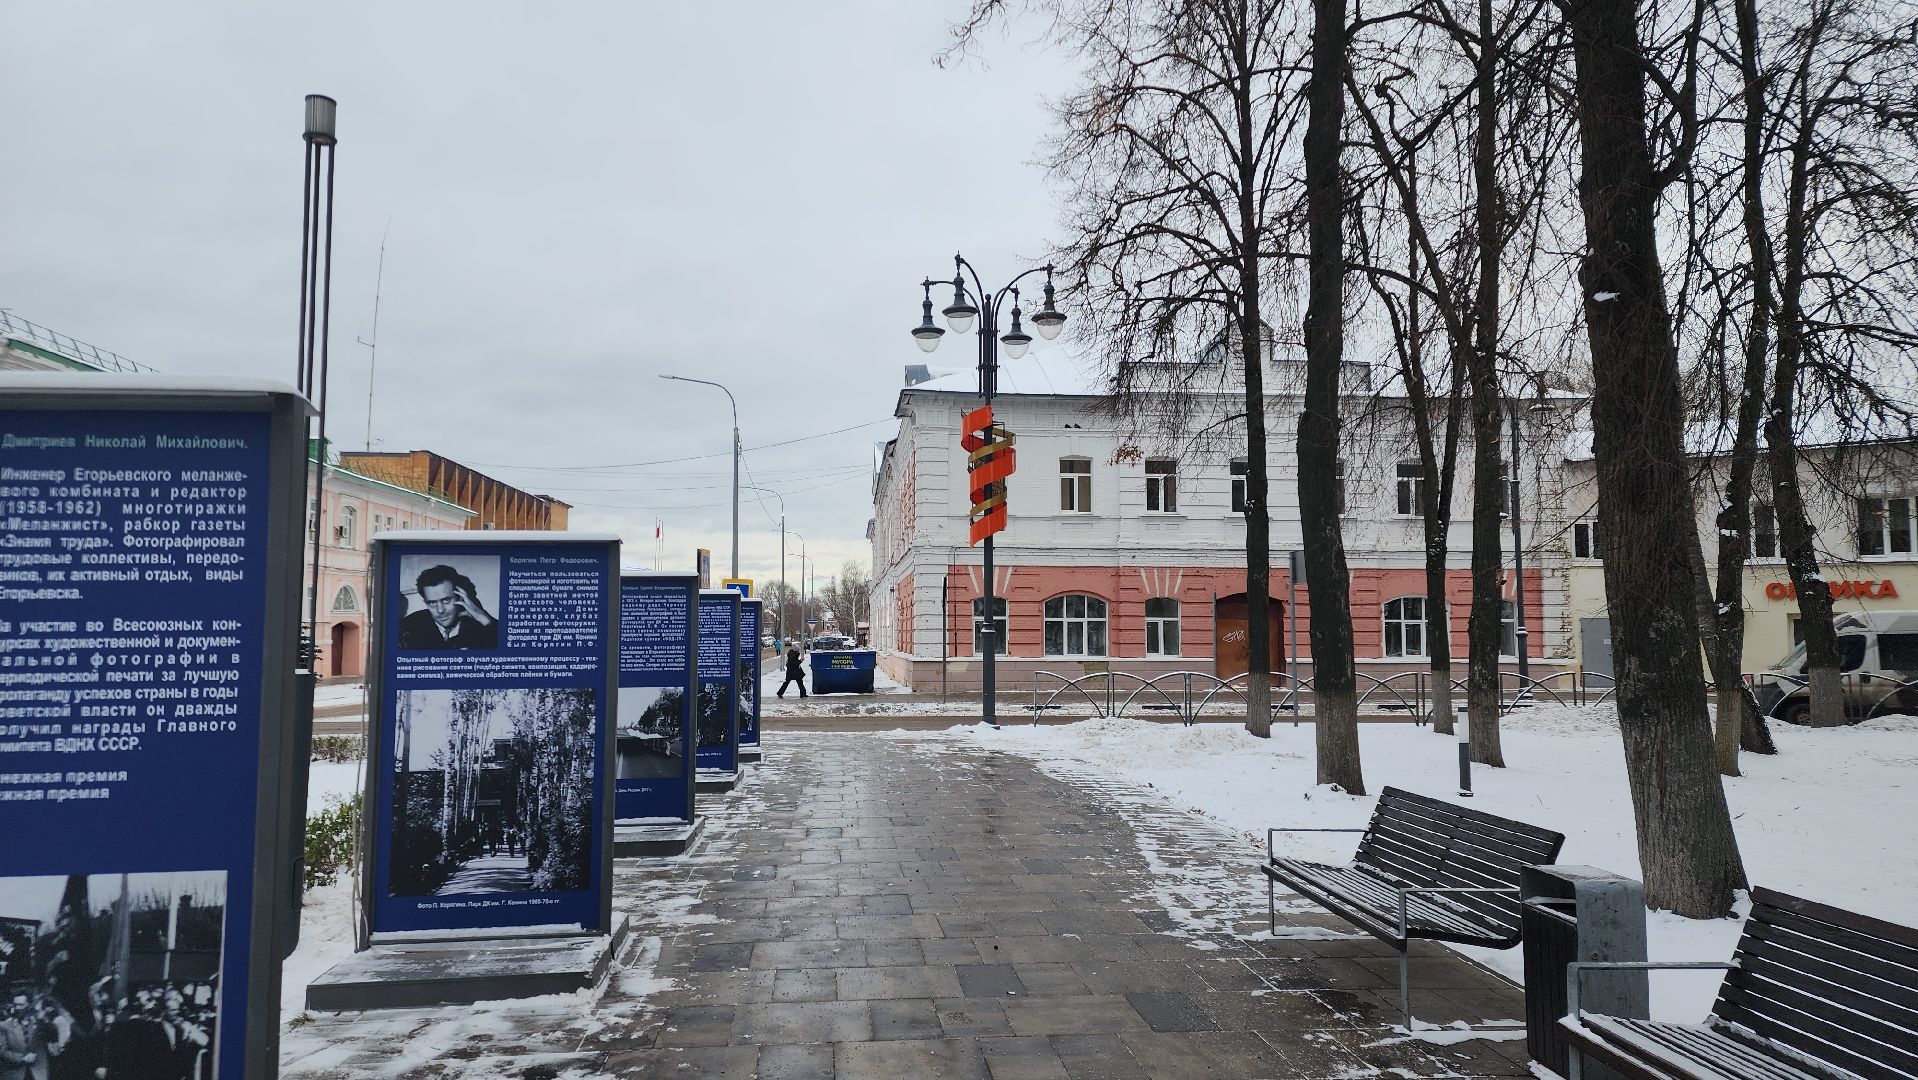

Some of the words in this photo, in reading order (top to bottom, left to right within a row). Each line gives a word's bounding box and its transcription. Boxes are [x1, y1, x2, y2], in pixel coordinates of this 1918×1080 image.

[1, 434, 76, 449] Дмитриев
[85, 435, 146, 448] Николай
[156, 435, 248, 448] Михайлович.
[1, 468, 65, 483] Инженер
[74, 468, 171, 483] Егорьевского
[182, 471, 247, 481] меланже-
[0, 487, 39, 497] вого
[50, 484, 139, 497] комбината
[151, 488, 159, 497] и
[171, 488, 246, 500] редактор
[0, 501, 101, 516] (1958-1962)
[123, 504, 245, 518] многотиражки
[0, 517, 113, 532] «Меланжист»,
[124, 517, 180, 534] рабкор
[191, 520, 245, 530] газеты
[61, 537, 113, 550] труда».
[123, 532, 245, 550] Фотографировал
[82, 554, 175, 565] коллективы,
[187, 554, 244, 566] передо-
[70, 568, 139, 581] активный
[145, 570, 192, 582] отдых,
[206, 570, 243, 582] виды
[19, 622, 77, 635] участие
[86, 621, 104, 632] во
[113, 618, 203, 631] Всесоюзных
[213, 620, 241, 630] кон-
[44, 634, 160, 652] художественной
[165, 637, 173, 647] и
[177, 637, 240, 650] докумен-
[0, 650, 77, 666] альной
[90, 651, 217, 668] фотографии
[232, 654, 240, 663] в
[106, 671, 153, 682] печати
[162, 671, 175, 681] за
[183, 670, 239, 684] лучшую
[74, 689, 131, 703] успехов
[135, 688, 187, 702] страны
[191, 688, 199, 698] в
[203, 687, 238, 699] годы
[81, 706, 136, 716] власти
[147, 705, 164, 716] он
[175, 704, 237, 717] дважды
[72, 723, 145, 736] награды
[157, 719, 236, 732] Главного
[54, 738, 95, 753] ВДНХ
[98, 737, 141, 751] СССР.
[66, 771, 127, 785] премия
[47, 788, 109, 802] премия
